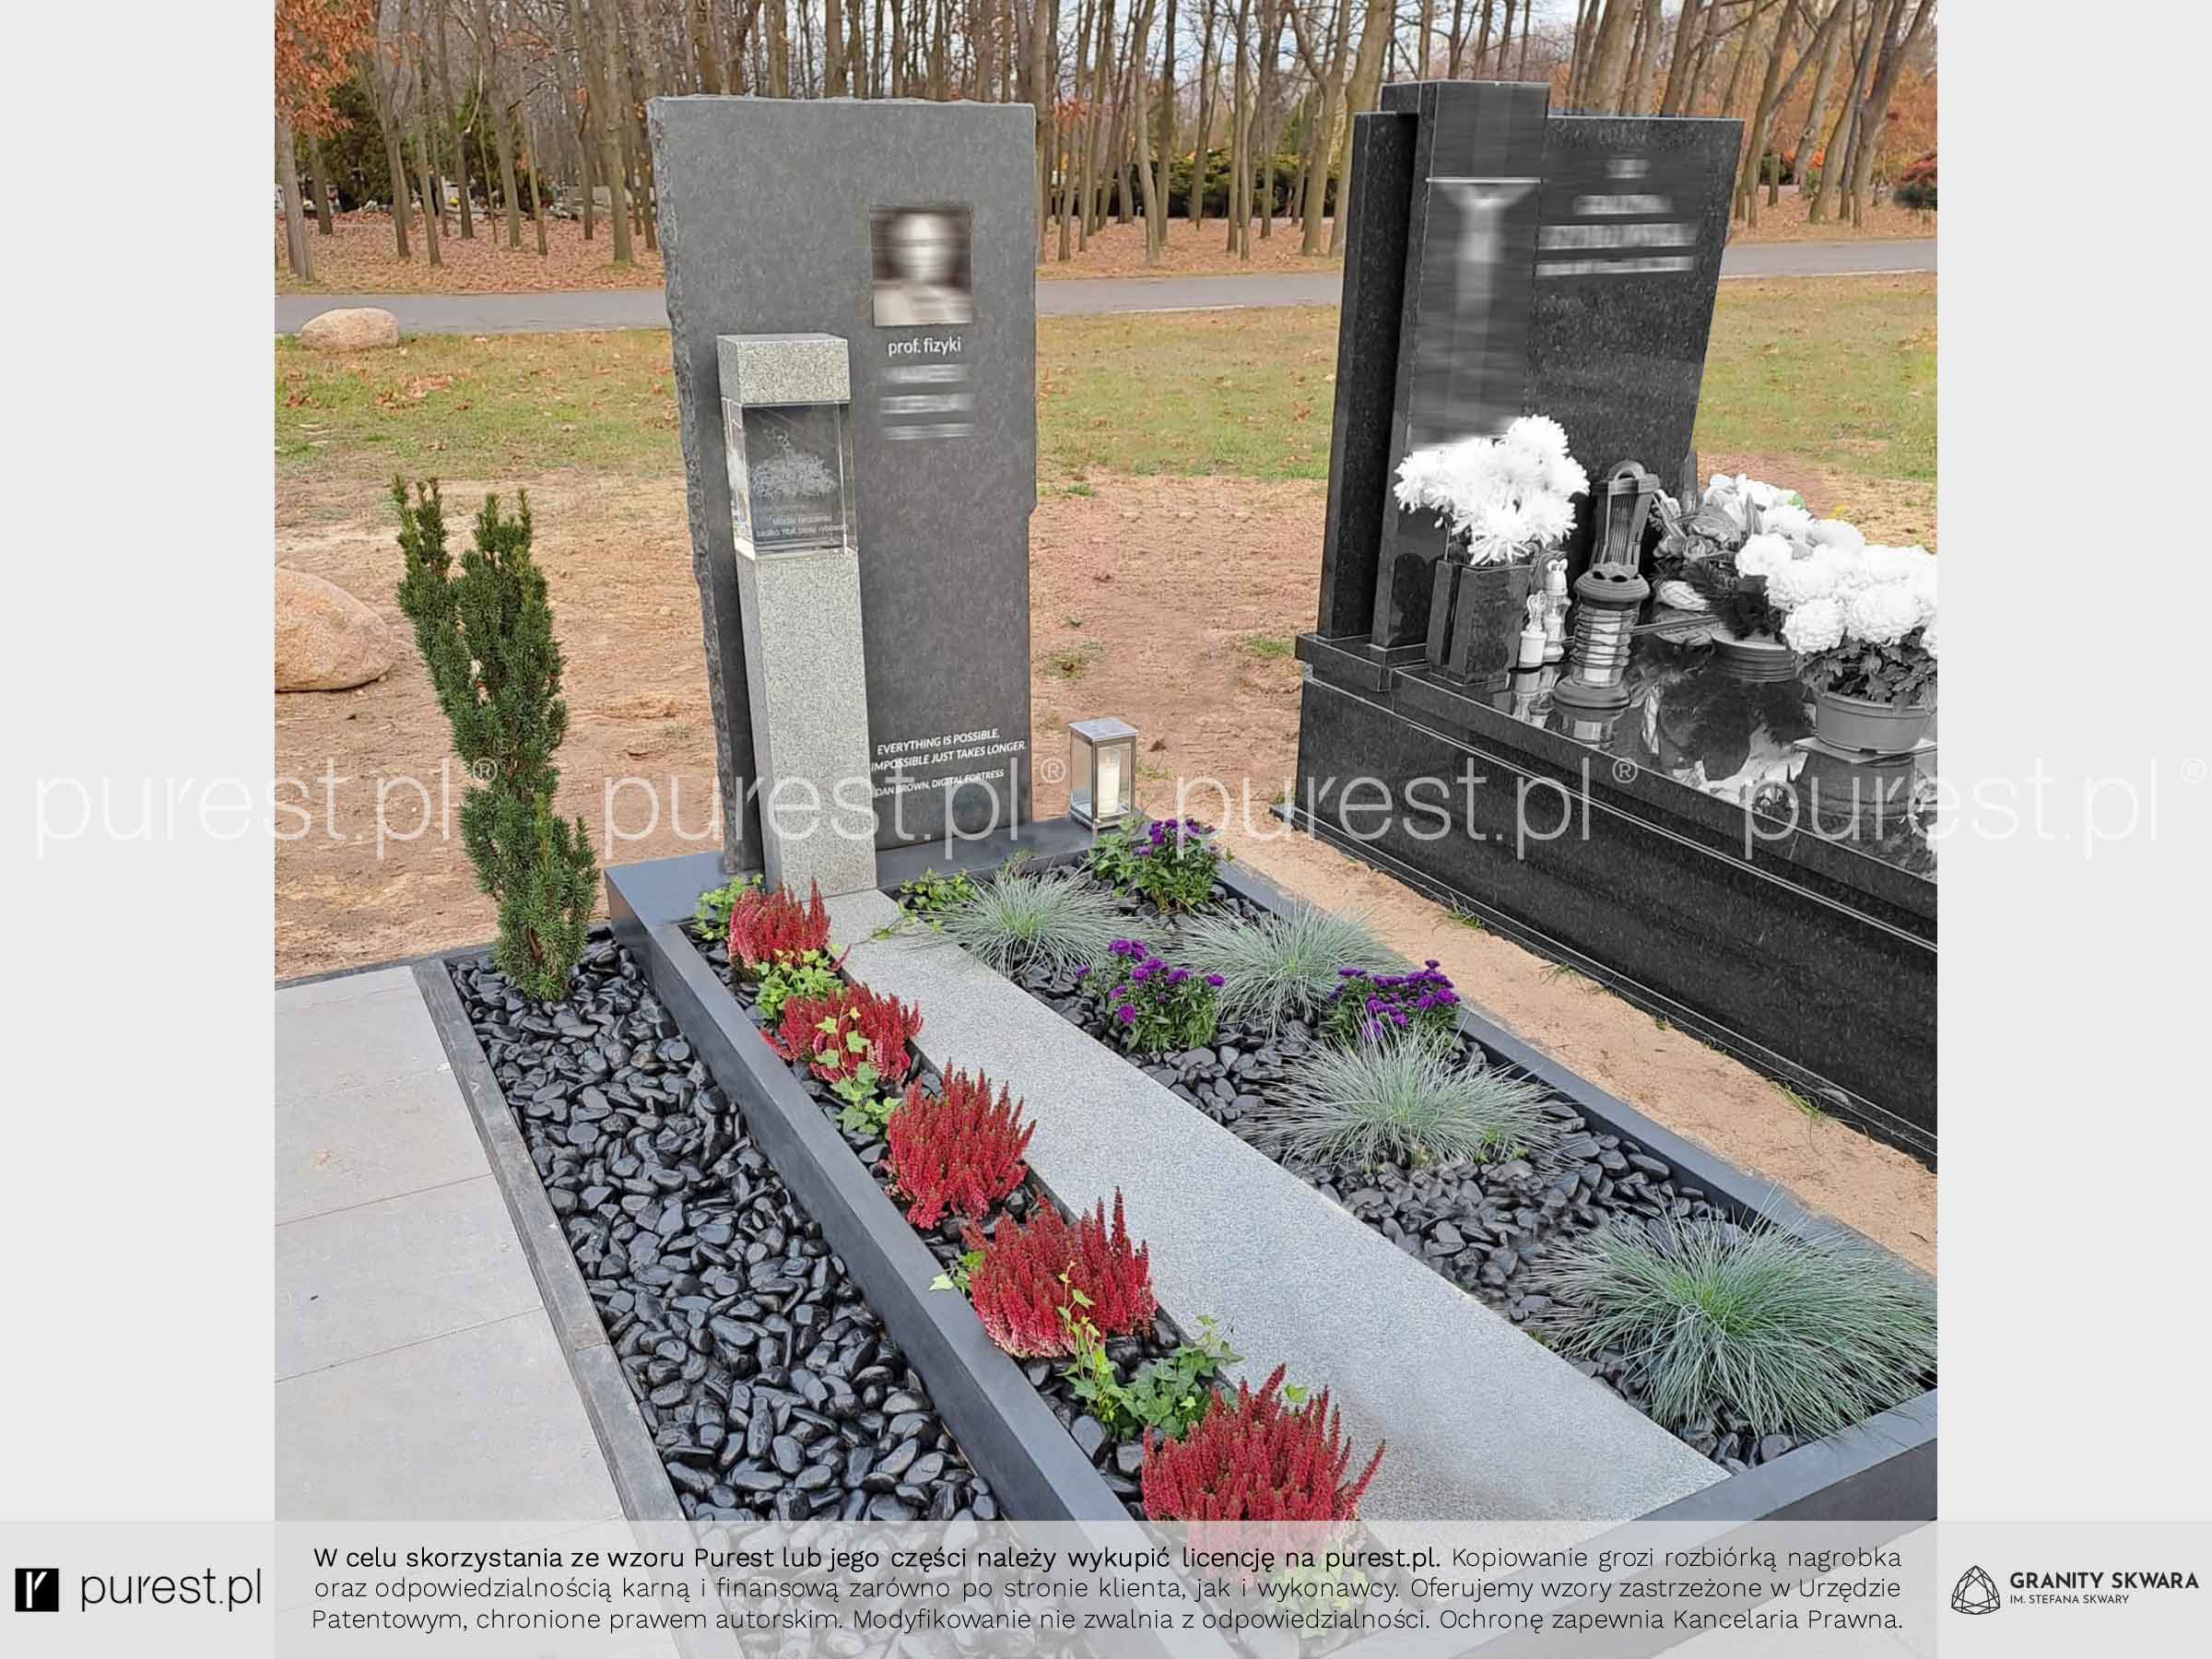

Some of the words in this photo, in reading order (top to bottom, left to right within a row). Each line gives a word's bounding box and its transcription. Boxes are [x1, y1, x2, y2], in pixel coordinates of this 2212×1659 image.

[888, 337, 921, 358] prof.
[924, 336, 961, 355] fizyki
[877, 736, 941, 756] EVERYTHING
[943, 735, 953, 747] IS
[953, 728, 1001, 744] POSSIBLE.
[871, 755, 930, 772] IMPOSSIBLE
[931, 750, 955, 764] JUST
[956, 747, 986, 760] TAKES
[876, 786, 895, 797] DAN
[931, 775, 966, 789] DIGITAL
[966, 769, 1005, 783] FORTRESS
